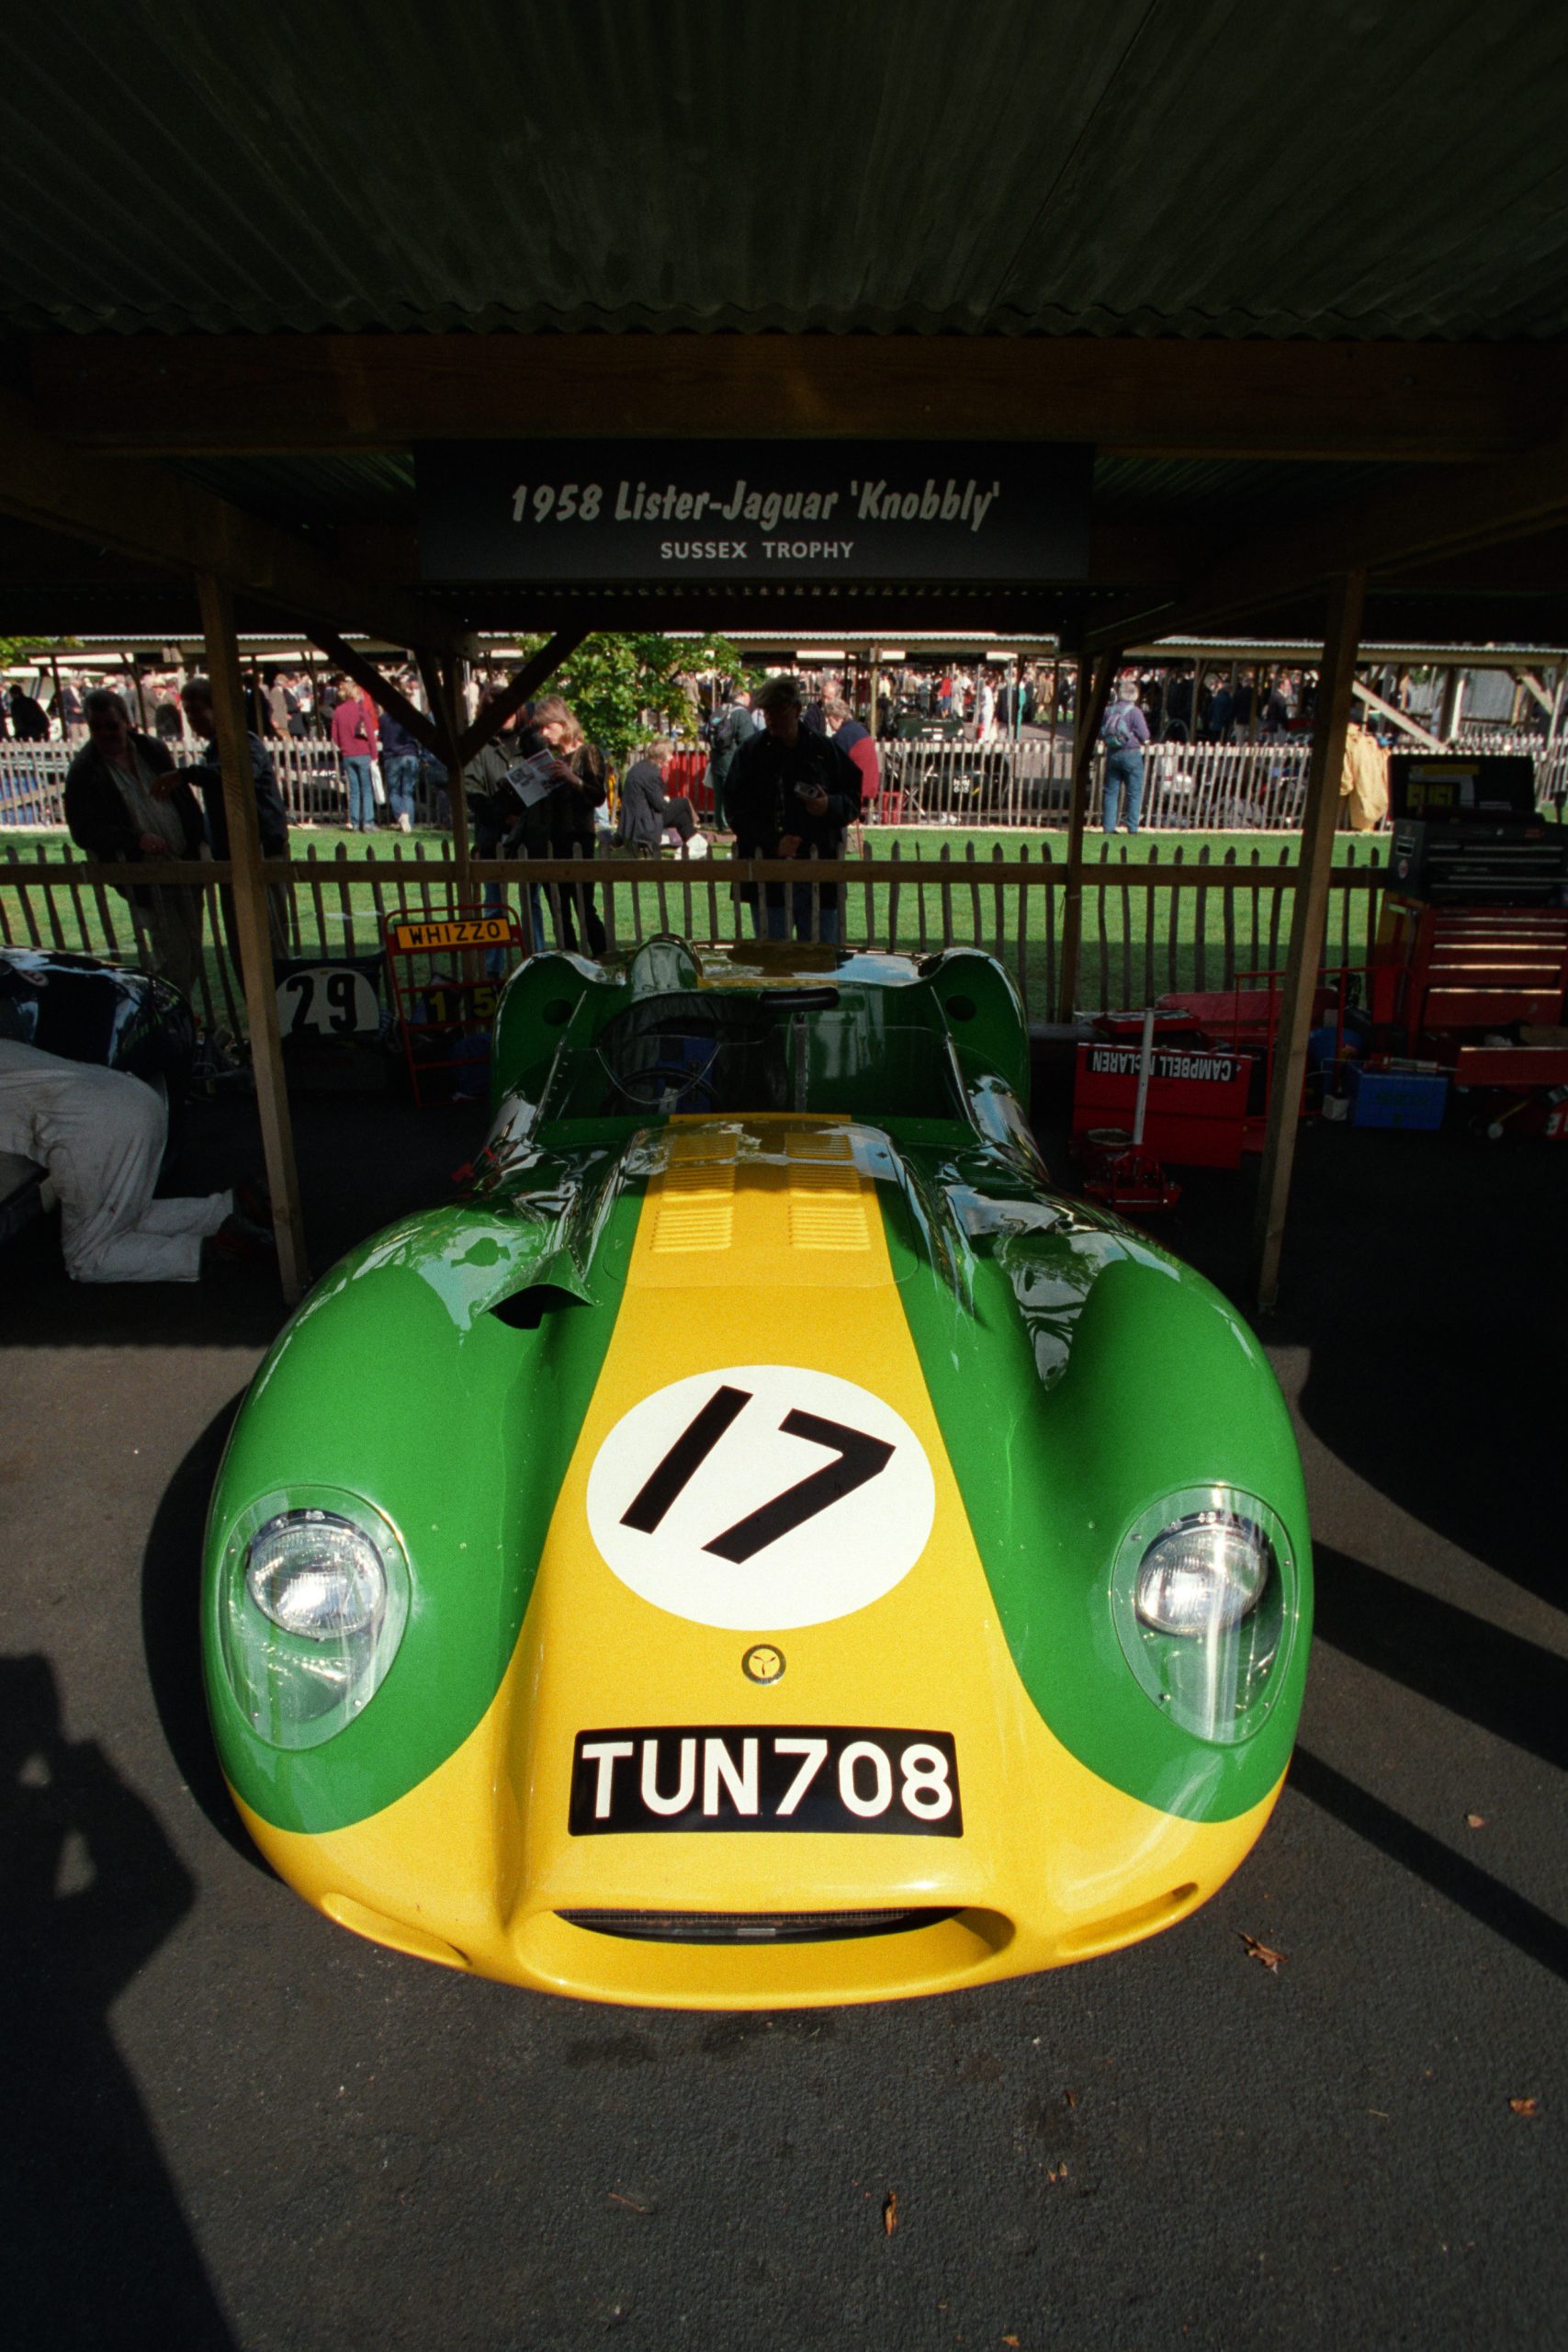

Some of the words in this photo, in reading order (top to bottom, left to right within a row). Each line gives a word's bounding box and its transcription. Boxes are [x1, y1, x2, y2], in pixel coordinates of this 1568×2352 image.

[511, 482, 604, 523] 1958
[614, 480, 840, 531] Lister-Jaguar
[850, 479, 1001, 533] 'Knobbly'
[660, 541, 748, 559] SUSSEX
[762, 541, 855, 559] TROPHY
[409, 922, 502, 945] WHIZZO
[287, 973, 357, 1035] 29
[1158, 1054, 1233, 1081] CAMPBELL
[618, 1384, 897, 1565] 17
